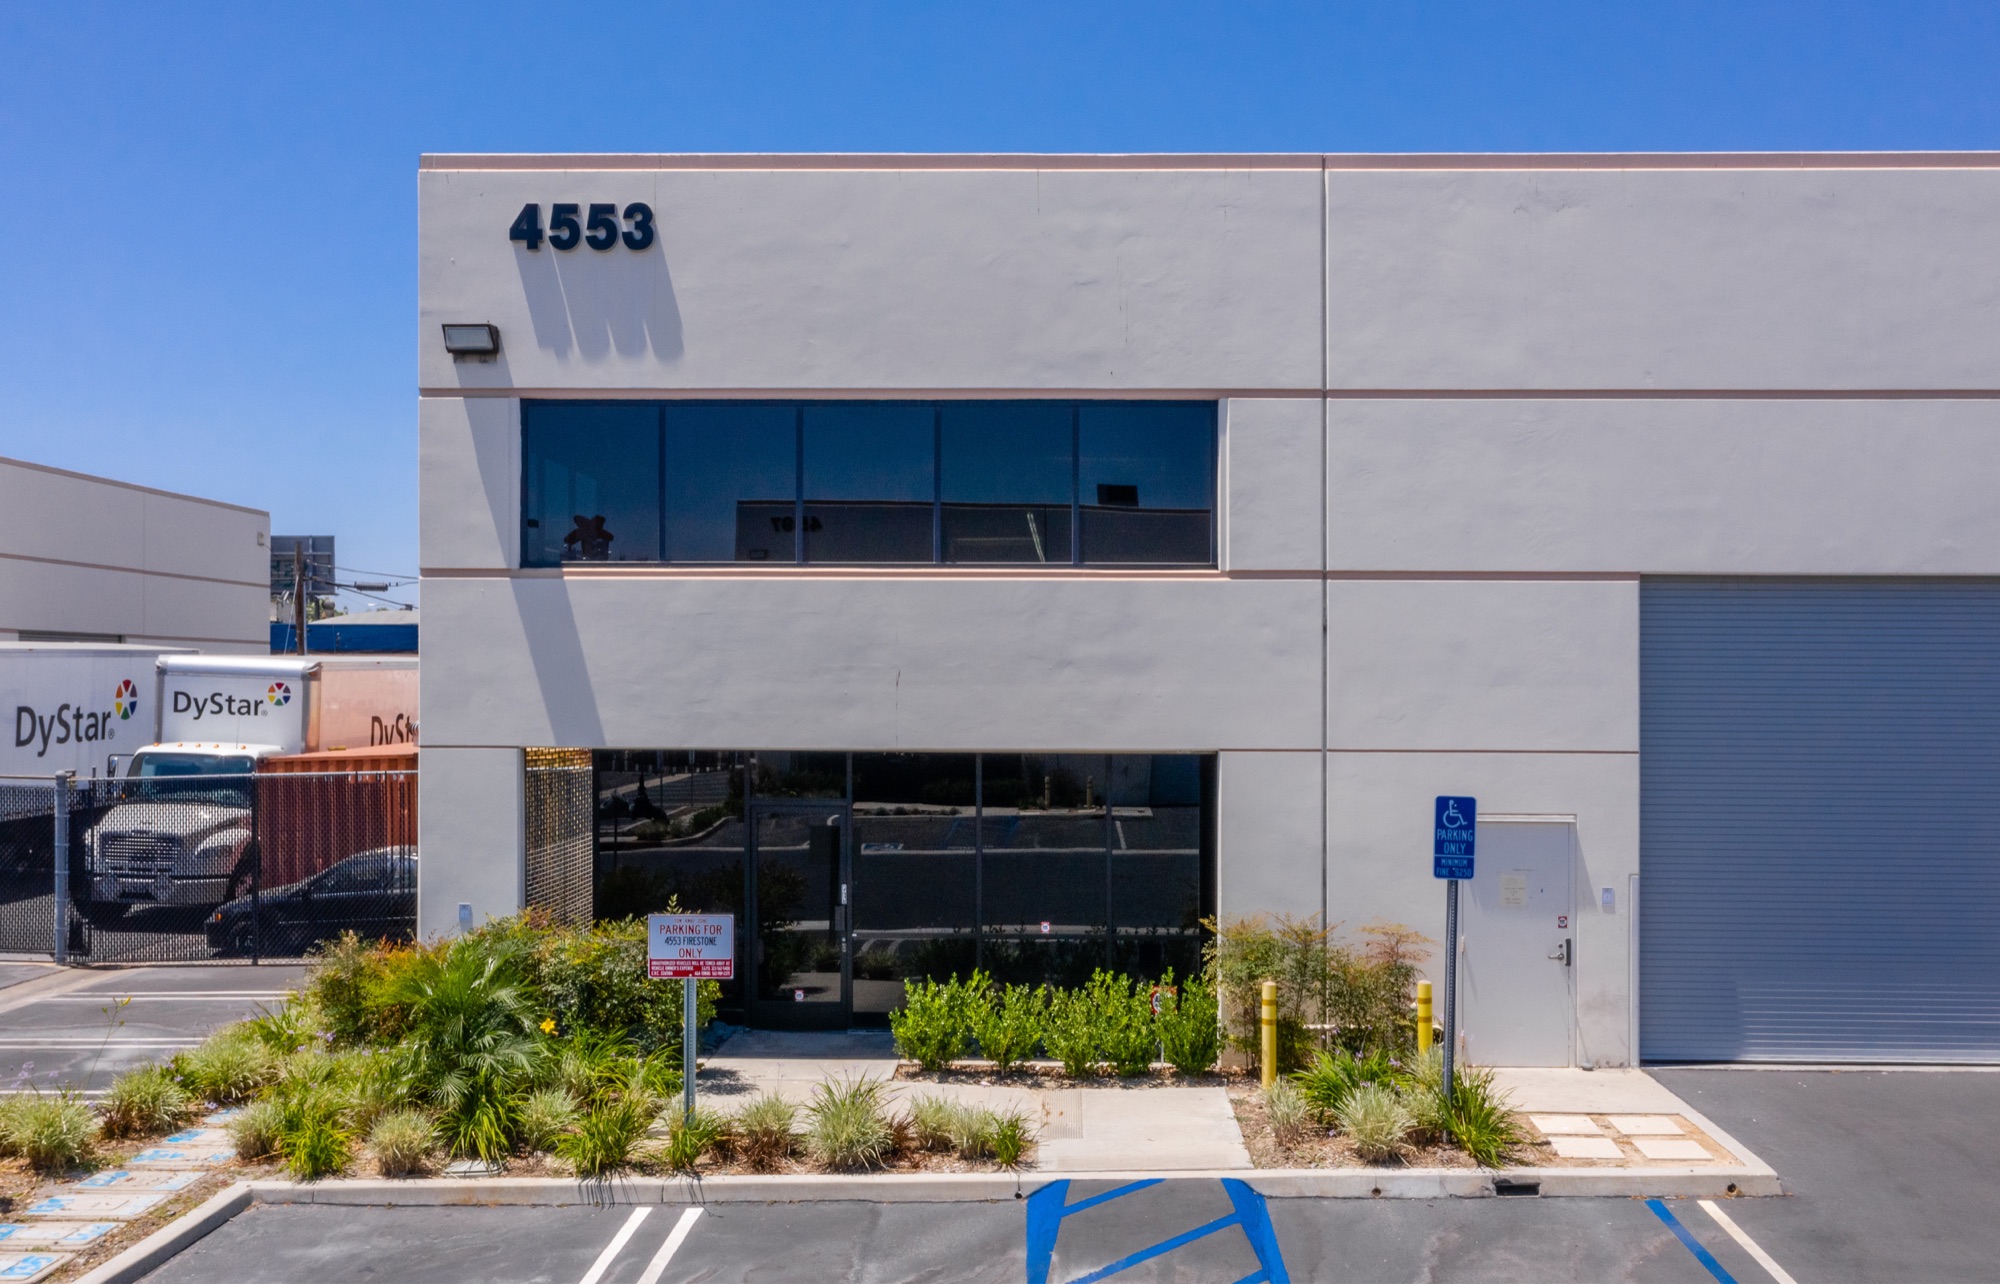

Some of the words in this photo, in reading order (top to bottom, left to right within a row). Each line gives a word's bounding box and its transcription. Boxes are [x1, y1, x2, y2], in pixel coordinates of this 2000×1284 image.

[509, 202, 654, 251] 4553
[173, 691, 264, 720] DyStar
[15, 703, 111, 757] DyStar
[1437, 829, 1473, 842] PARKING
[1443, 842, 1466, 855] ONLY
[1441, 858, 1468, 867] MINIMUM
[1436, 867, 1450, 877] FINE
[659, 924, 701, 935] PARKING
[704, 924, 722, 935] FOR
[664, 936, 681, 946] 4553
[683, 936, 717, 946] FIRESTONE
[678, 948, 703, 958] ONLY
